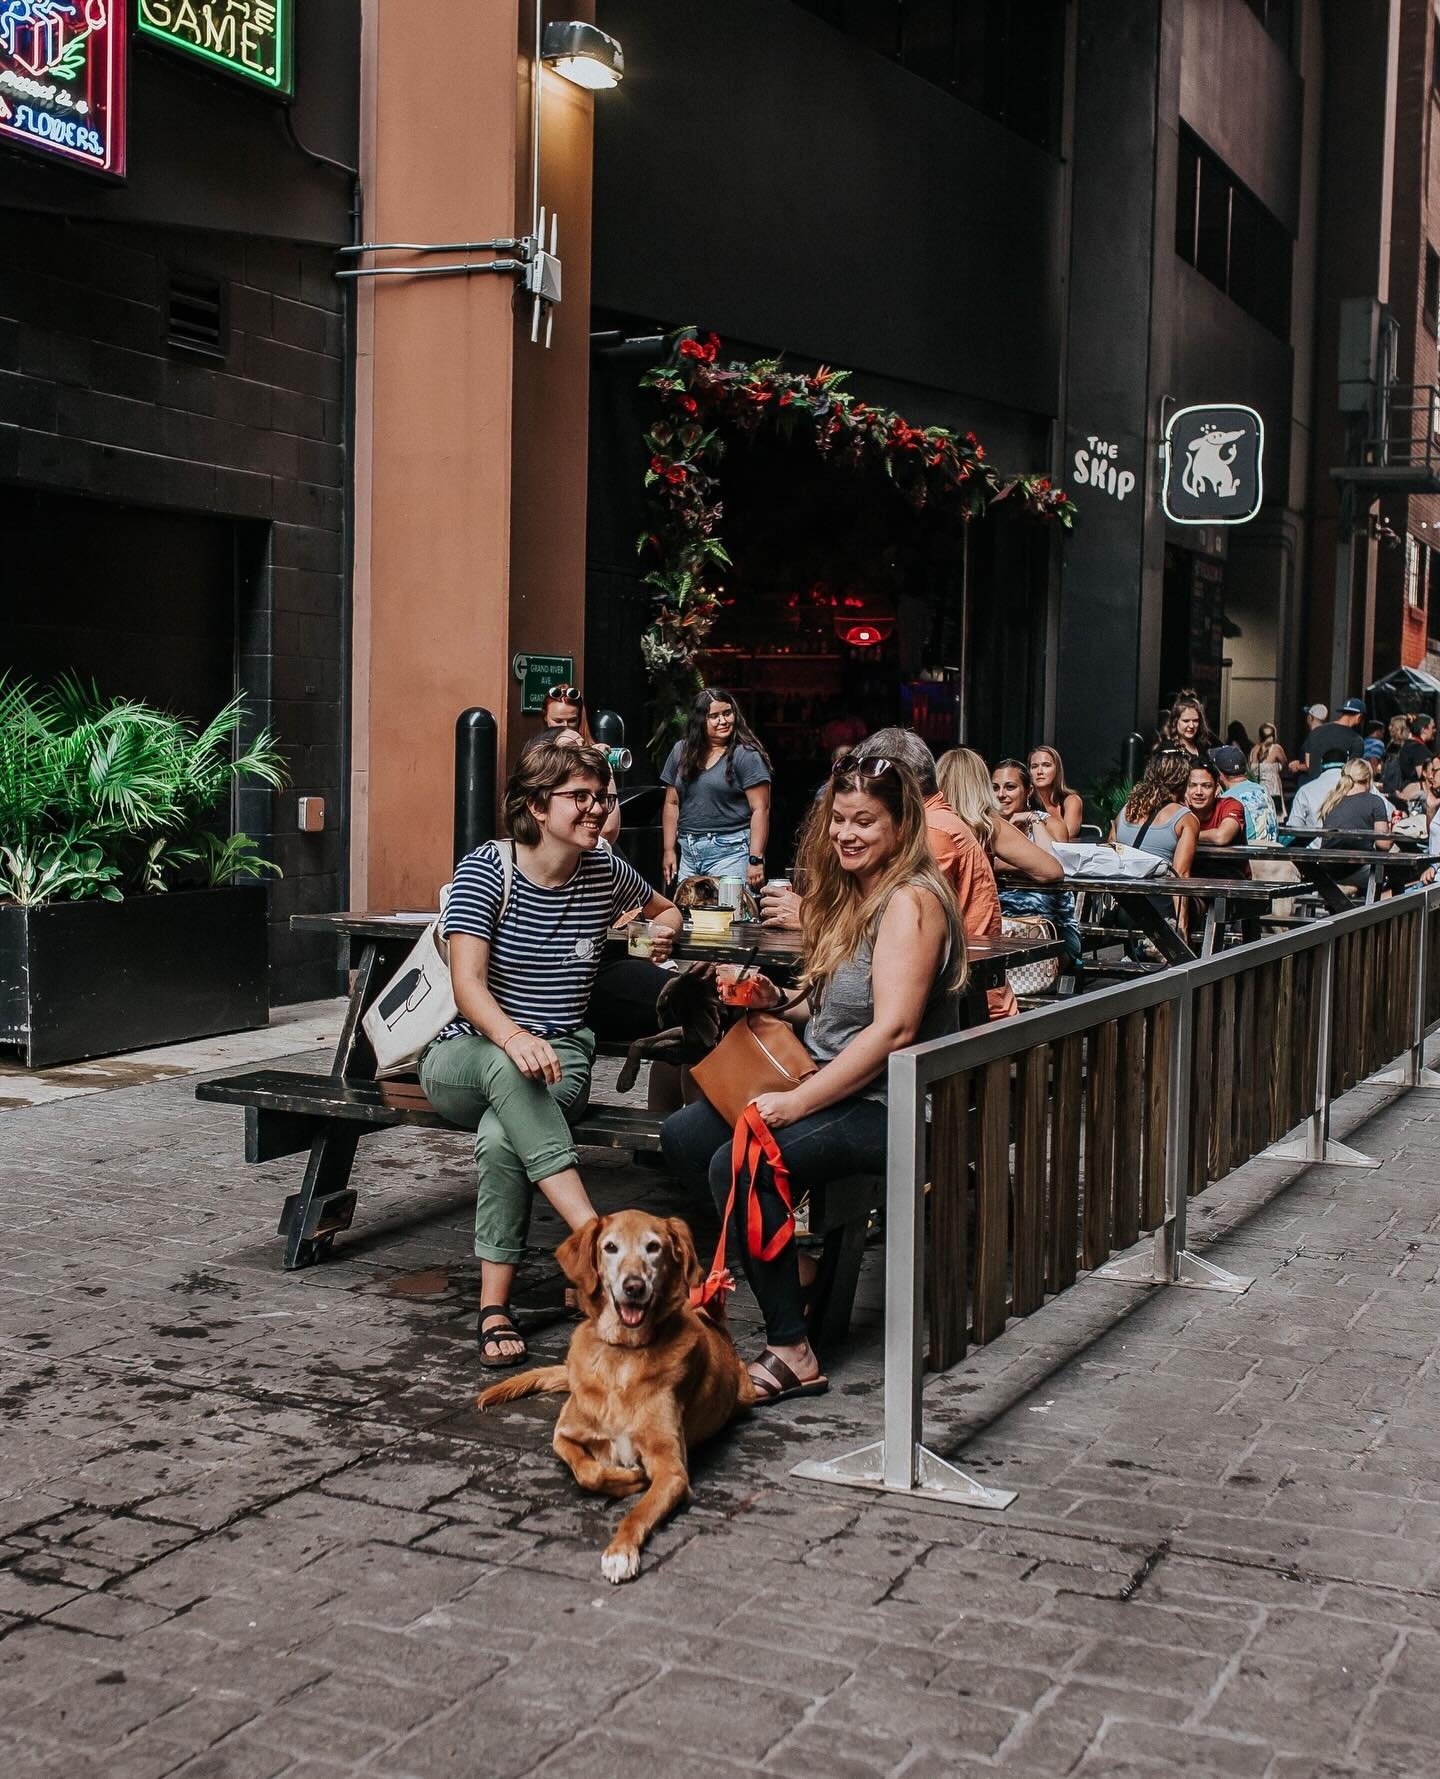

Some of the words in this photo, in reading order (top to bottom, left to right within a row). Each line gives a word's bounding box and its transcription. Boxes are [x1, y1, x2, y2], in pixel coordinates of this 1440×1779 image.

[1087, 436, 1119, 459] THE
[1073, 450, 1136, 501] SKIP
[530, 664, 549, 673] GRAND
[550, 665, 564, 674] RIVER
